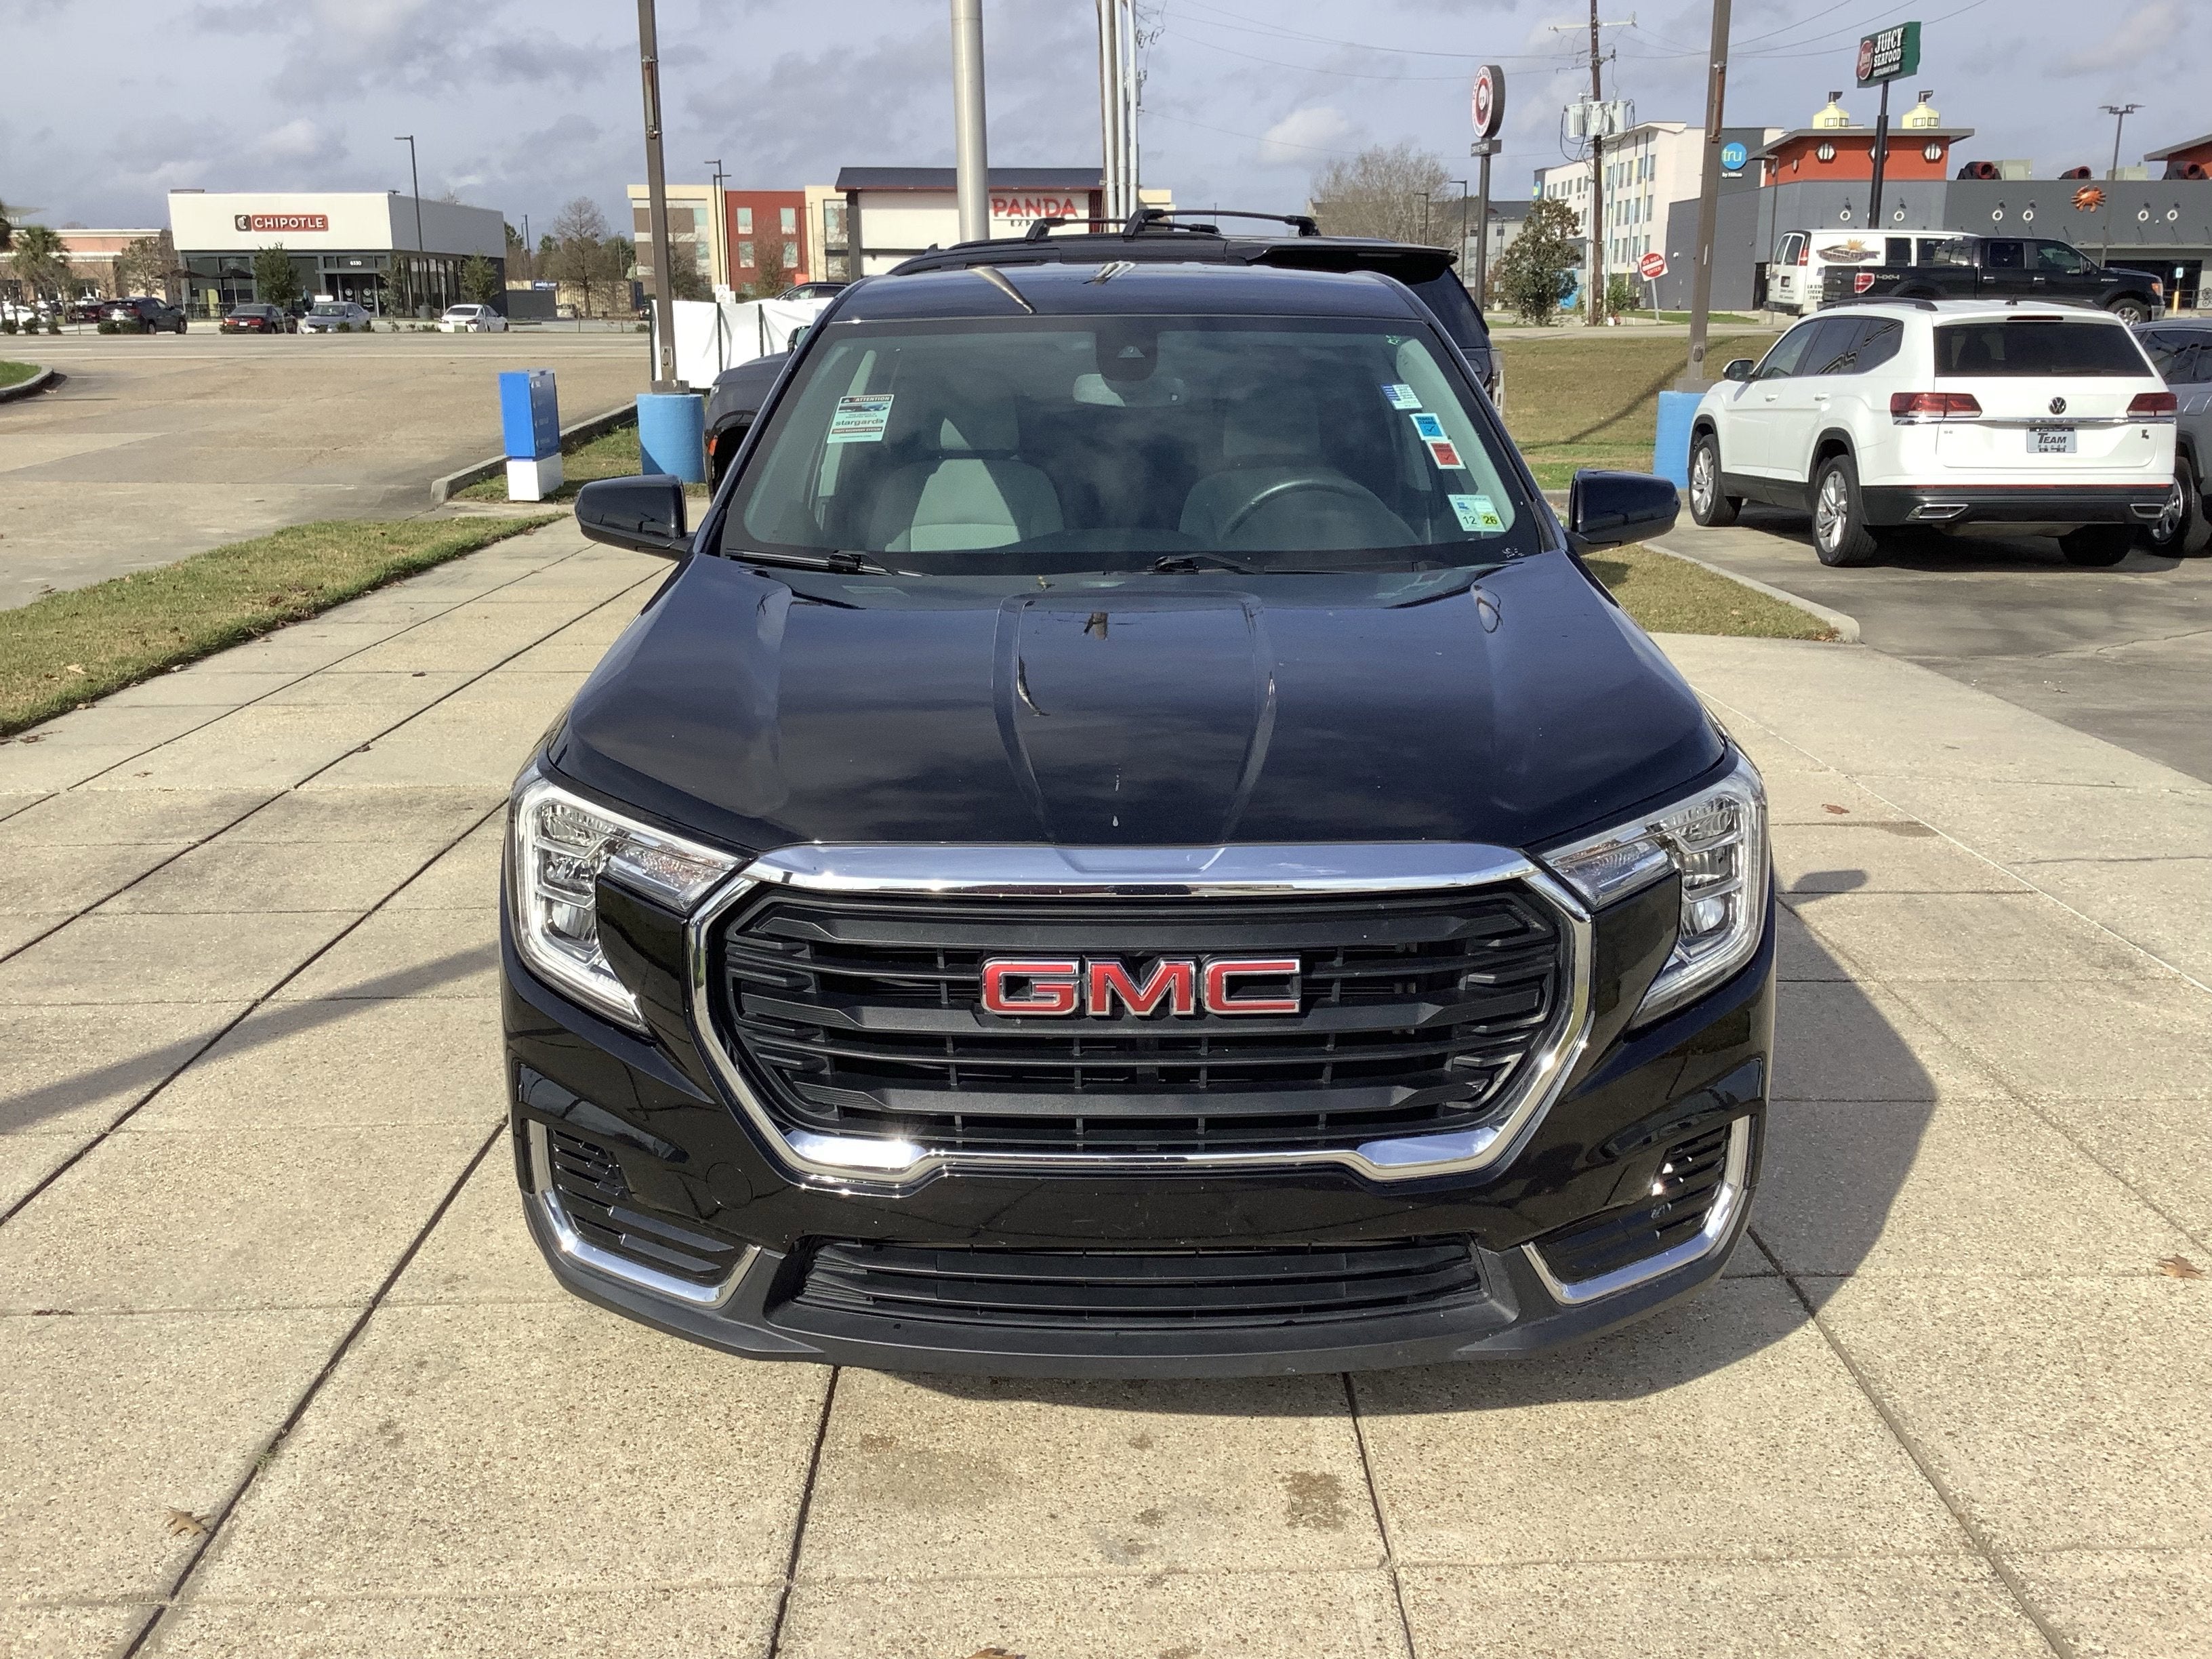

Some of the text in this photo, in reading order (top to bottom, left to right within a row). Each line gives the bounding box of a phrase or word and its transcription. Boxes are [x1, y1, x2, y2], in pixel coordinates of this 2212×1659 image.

[1875, 27, 1904, 54] JUICY
[1873, 48, 1901, 67] SEAFOOD
[1723, 148, 1742, 162] tru
[991, 198, 1078, 217] PANDA
[254, 218, 324, 228] CHIPOTLE
[1647, 266, 1662, 275] ENTER
[2037, 432, 2067, 443] TEAM
[1462, 516, 1498, 525] 12 26
[981, 956, 1300, 1016] GMC
